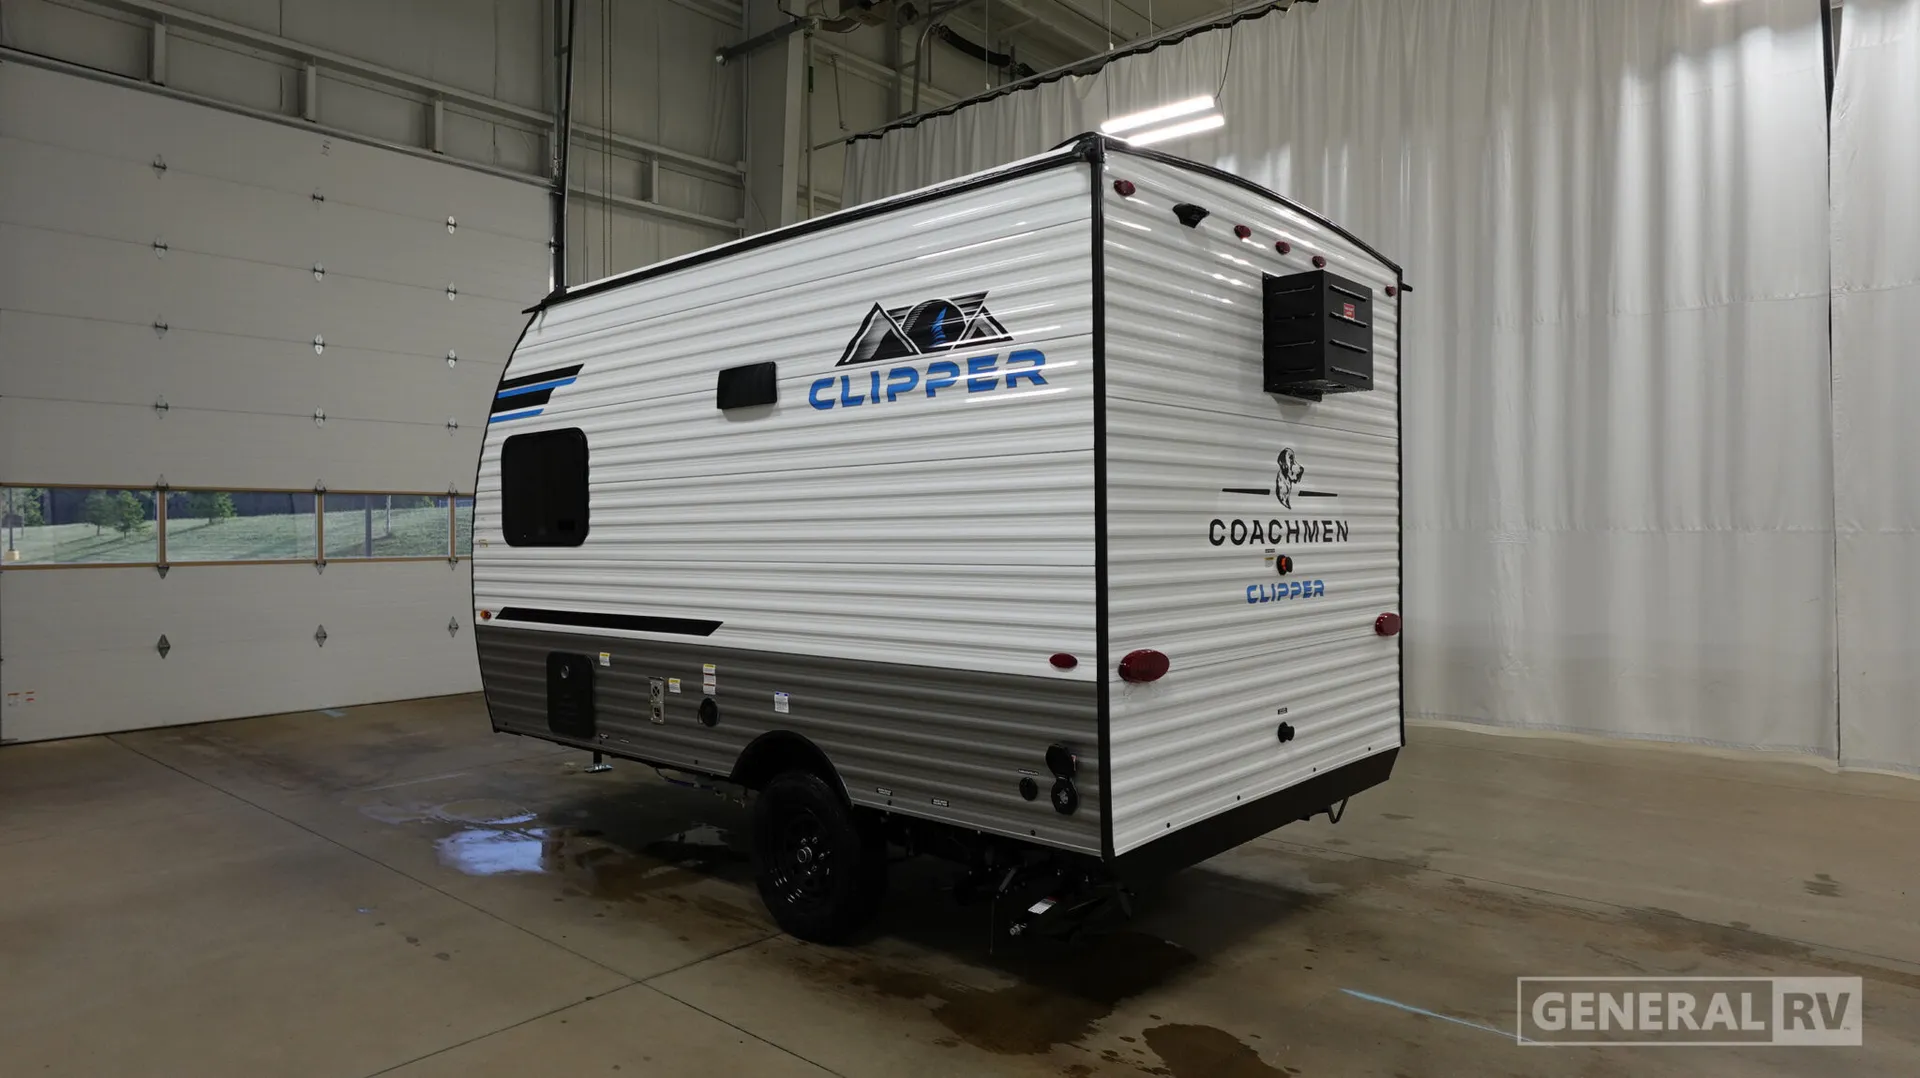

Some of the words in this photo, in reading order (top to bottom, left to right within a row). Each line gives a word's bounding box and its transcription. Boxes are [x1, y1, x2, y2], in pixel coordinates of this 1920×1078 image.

[808, 348, 1048, 411] CLIPPER
[1208, 518, 1349, 546] COACHMEN
[1246, 579, 1325, 604] CLIPPER
